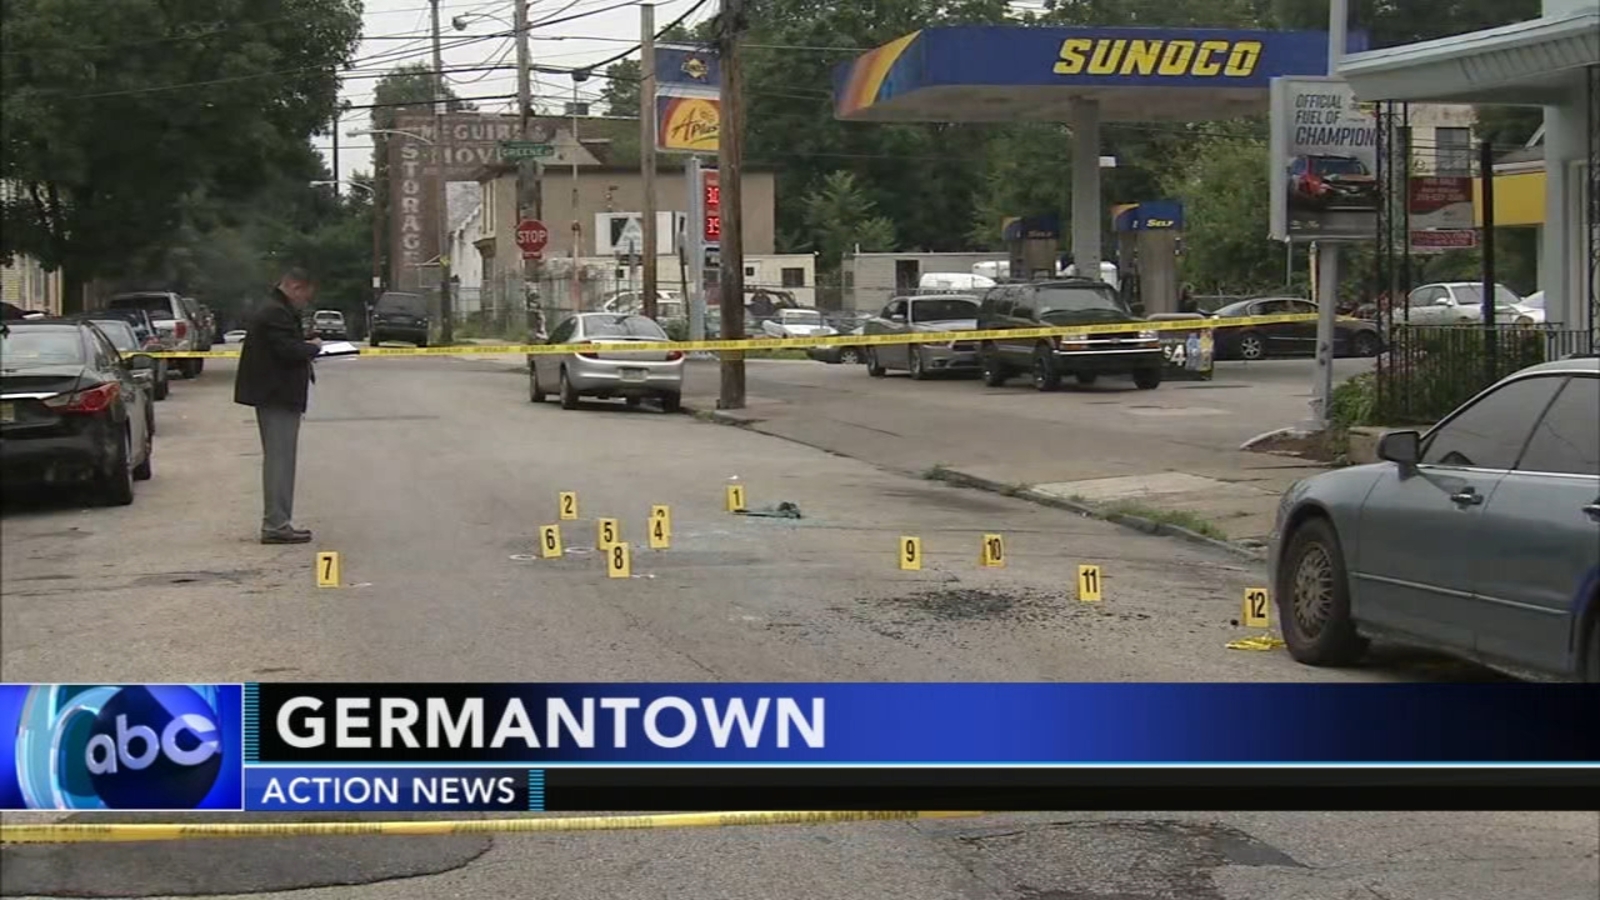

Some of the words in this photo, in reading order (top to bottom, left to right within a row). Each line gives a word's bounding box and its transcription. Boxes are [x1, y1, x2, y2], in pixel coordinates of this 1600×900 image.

[1052, 38, 1263, 77] SUNOCO
[1295, 94, 1342, 109] OFFICIAL
[1295, 110, 1322, 125] FUEL
[1325, 110, 1342, 125] OF
[401, 143, 421, 263] STORAGE
[518, 230, 546, 243] STOP
[1164, 344, 1187, 367] $4
[564, 495, 573, 514] 2
[733, 489, 740, 506] 1
[545, 528, 556, 550] 6
[603, 522, 613, 543] 5
[654, 520, 664, 541] 4
[614, 546, 624, 570] 8
[905, 540, 915, 562] 9
[987, 538, 1001, 561] 10
[322, 556, 332, 581] 7
[1082, 569, 1098, 594] 11
[1248, 593, 1266, 618] 12
